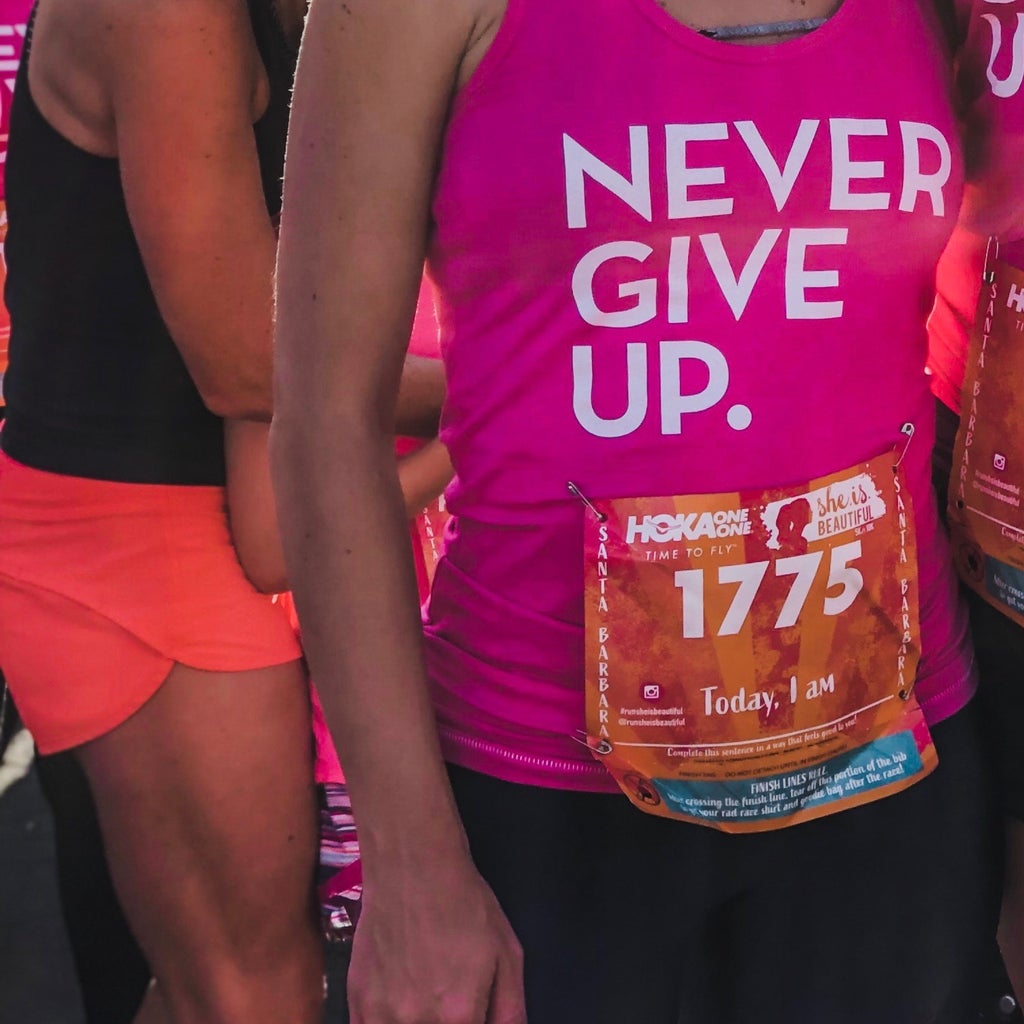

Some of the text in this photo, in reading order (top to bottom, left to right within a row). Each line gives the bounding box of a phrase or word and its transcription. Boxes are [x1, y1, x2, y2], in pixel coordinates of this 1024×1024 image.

[563, 118, 951, 228] NEVER
[571, 228, 849, 328] GIVE
[978, 283, 997, 369] SANTA
[572, 341, 752, 437] UP.
[958, 381, 980, 499] BARBARA
[625, 511, 717, 543] HOKA
[713, 508, 750, 525] ONE
[716, 521, 752, 538] ONE
[818, 505, 875, 536] BEAUTIFUL
[893, 476, 908, 563] SANTA
[598, 526, 609, 613] SANTA
[646, 549, 680, 561] TIME
[686, 547, 704, 558] TO
[674, 540, 865, 639] 1775
[897, 578, 912, 687] BARBARA
[598, 626, 610, 737] BARBARA
[700, 685, 780, 717] Today,
[790, 676, 798, 704] I
[667, 747, 702, 758] Complete
[705, 748, 720, 756] this
[721, 746, 754, 756] sentence
[772, 741, 787, 749] way
[787, 736, 803, 746] that
[804, 730, 820, 743] feels
[821, 724, 838, 740] good
[685, 798, 722, 809] crossing
[724, 797, 740, 807] the
[741, 792, 768, 807] finish
[790, 786, 806, 798] tear
[807, 780, 818, 792] off
[818, 776, 833, 787] this
[834, 765, 865, 782] portion
[866, 760, 876, 772] of
[876, 757, 891, 769] the
[891, 751, 907, 763] bib
[721, 808, 738, 818] rad
[740, 807, 759, 816] race
[760, 804, 781, 815] shirt
[783, 800, 799, 811] and
[826, 784, 844, 796] bag
[845, 777, 865, 791] after
[866, 772, 881, 784] the
[882, 763, 905, 779] race!
[750, 781, 781, 795] FINISH
[782, 773, 807, 789] LINES
